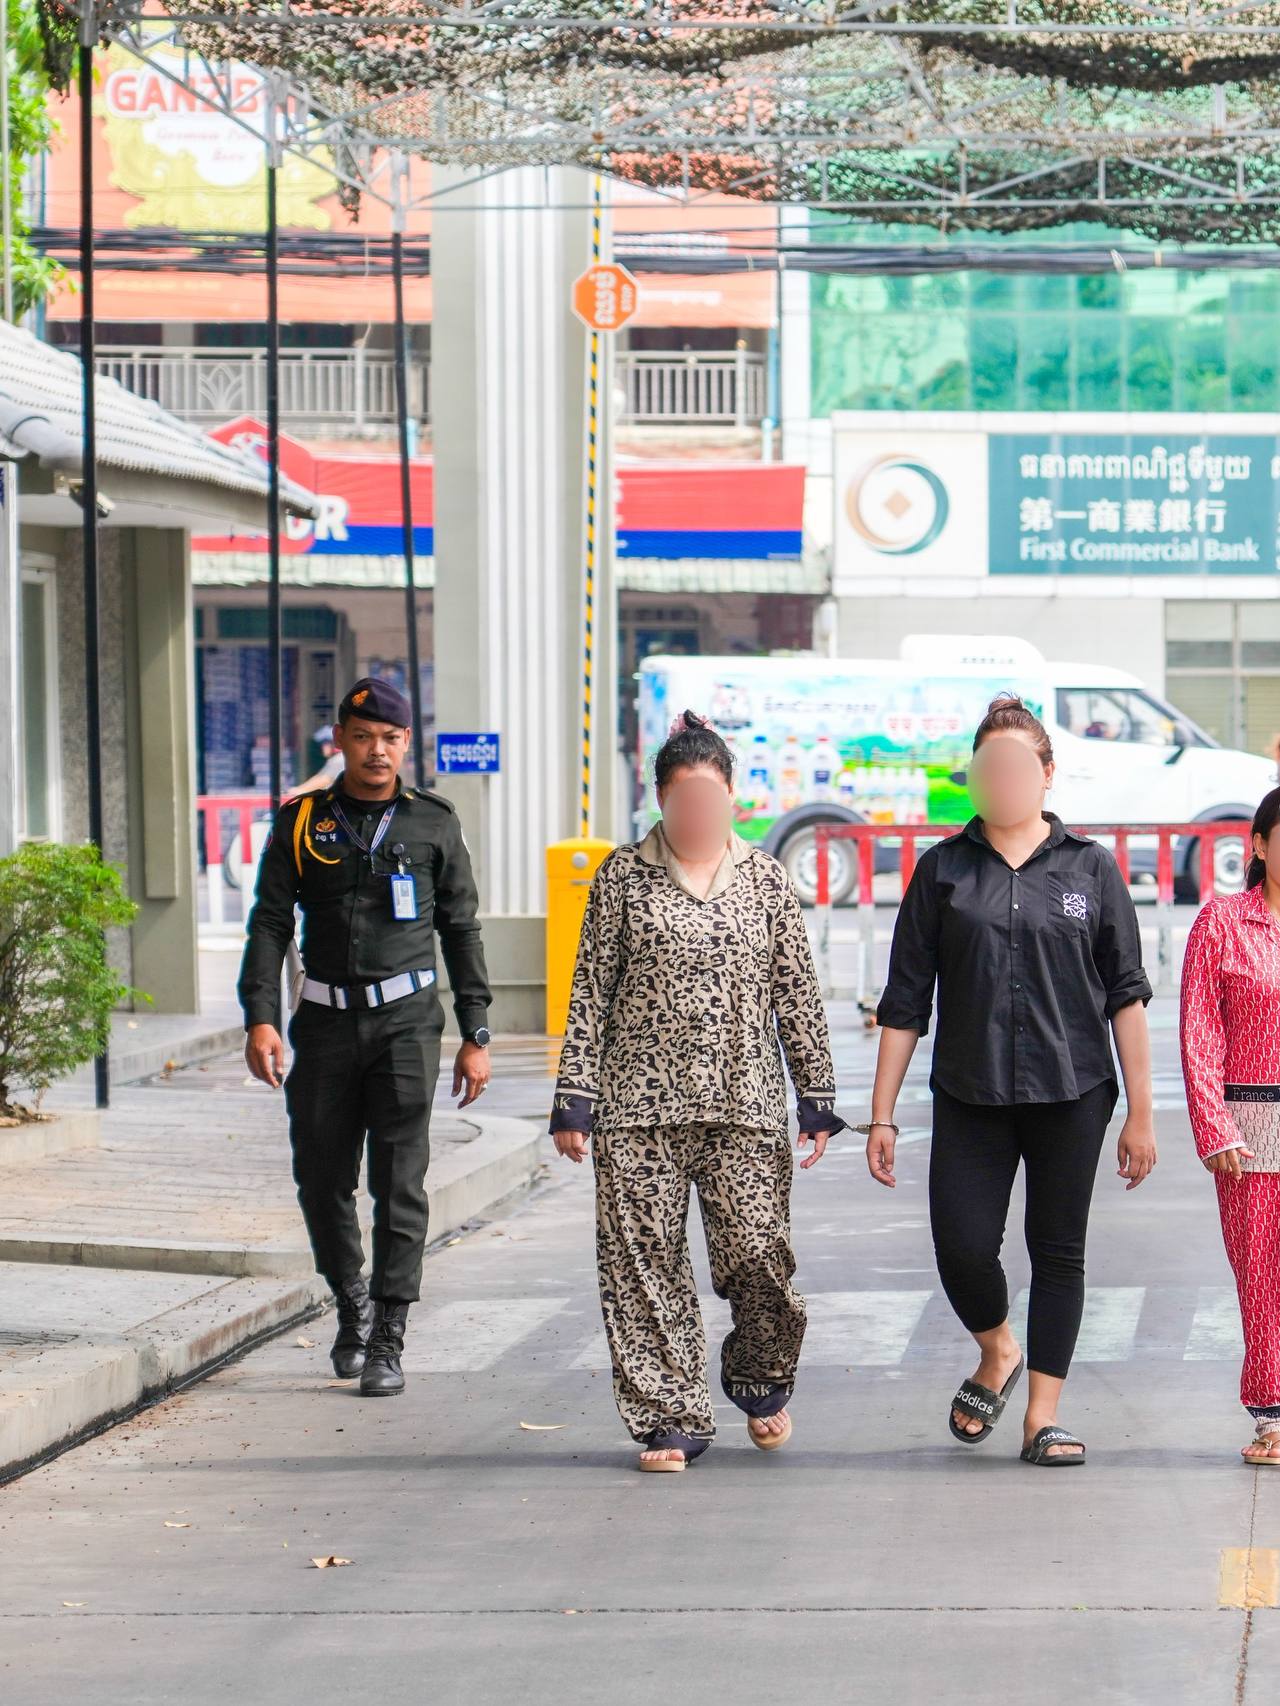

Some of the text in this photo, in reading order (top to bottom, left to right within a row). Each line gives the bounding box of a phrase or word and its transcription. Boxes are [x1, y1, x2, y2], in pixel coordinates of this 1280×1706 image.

[1019, 497, 1227, 533] 第一商業銀行
[1020, 536, 1067, 561] First
[1070, 537, 1199, 561] Commercial
[1204, 536, 1260, 561] Bank
[1233, 1087, 1274, 1101] France
[731, 1383, 772, 1397] PINK
